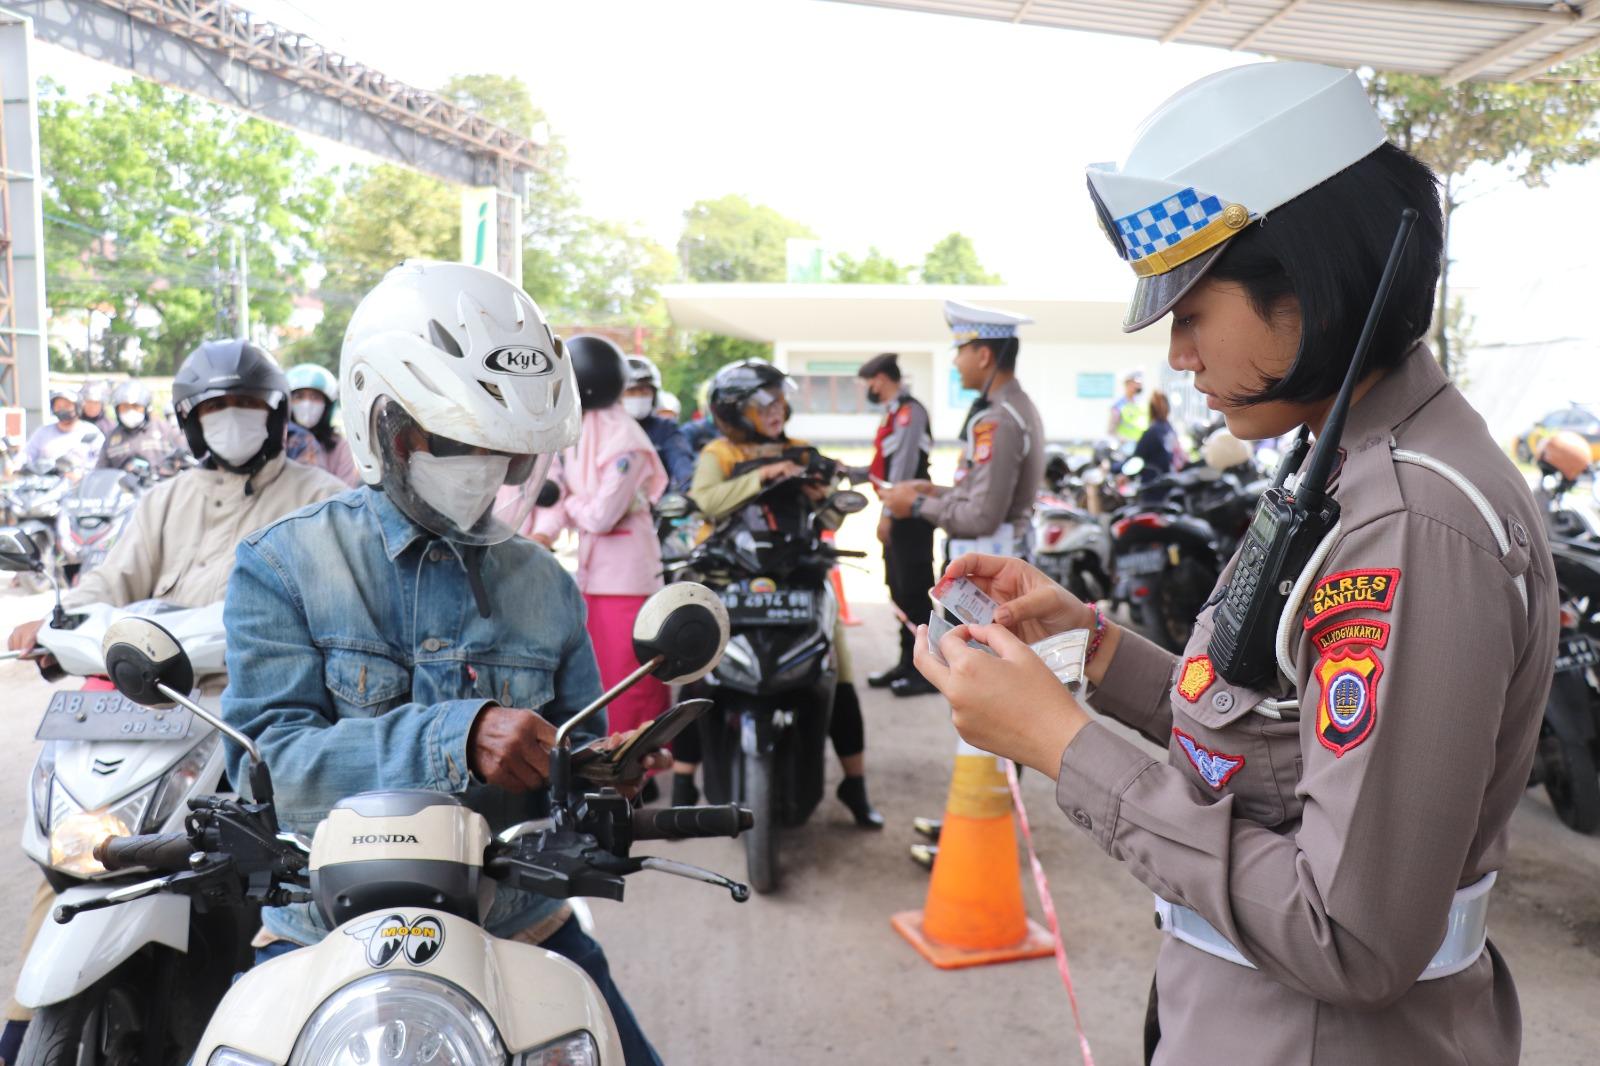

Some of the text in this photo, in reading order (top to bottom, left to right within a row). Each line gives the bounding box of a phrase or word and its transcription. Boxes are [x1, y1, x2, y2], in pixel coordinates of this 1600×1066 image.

[1313, 576, 1387, 602] OLRES
[1313, 587, 1377, 615] BANTUL
[50, 694, 84, 714] AB
[351, 834, 419, 845] HONDA
[381, 927, 436, 938] MOON
